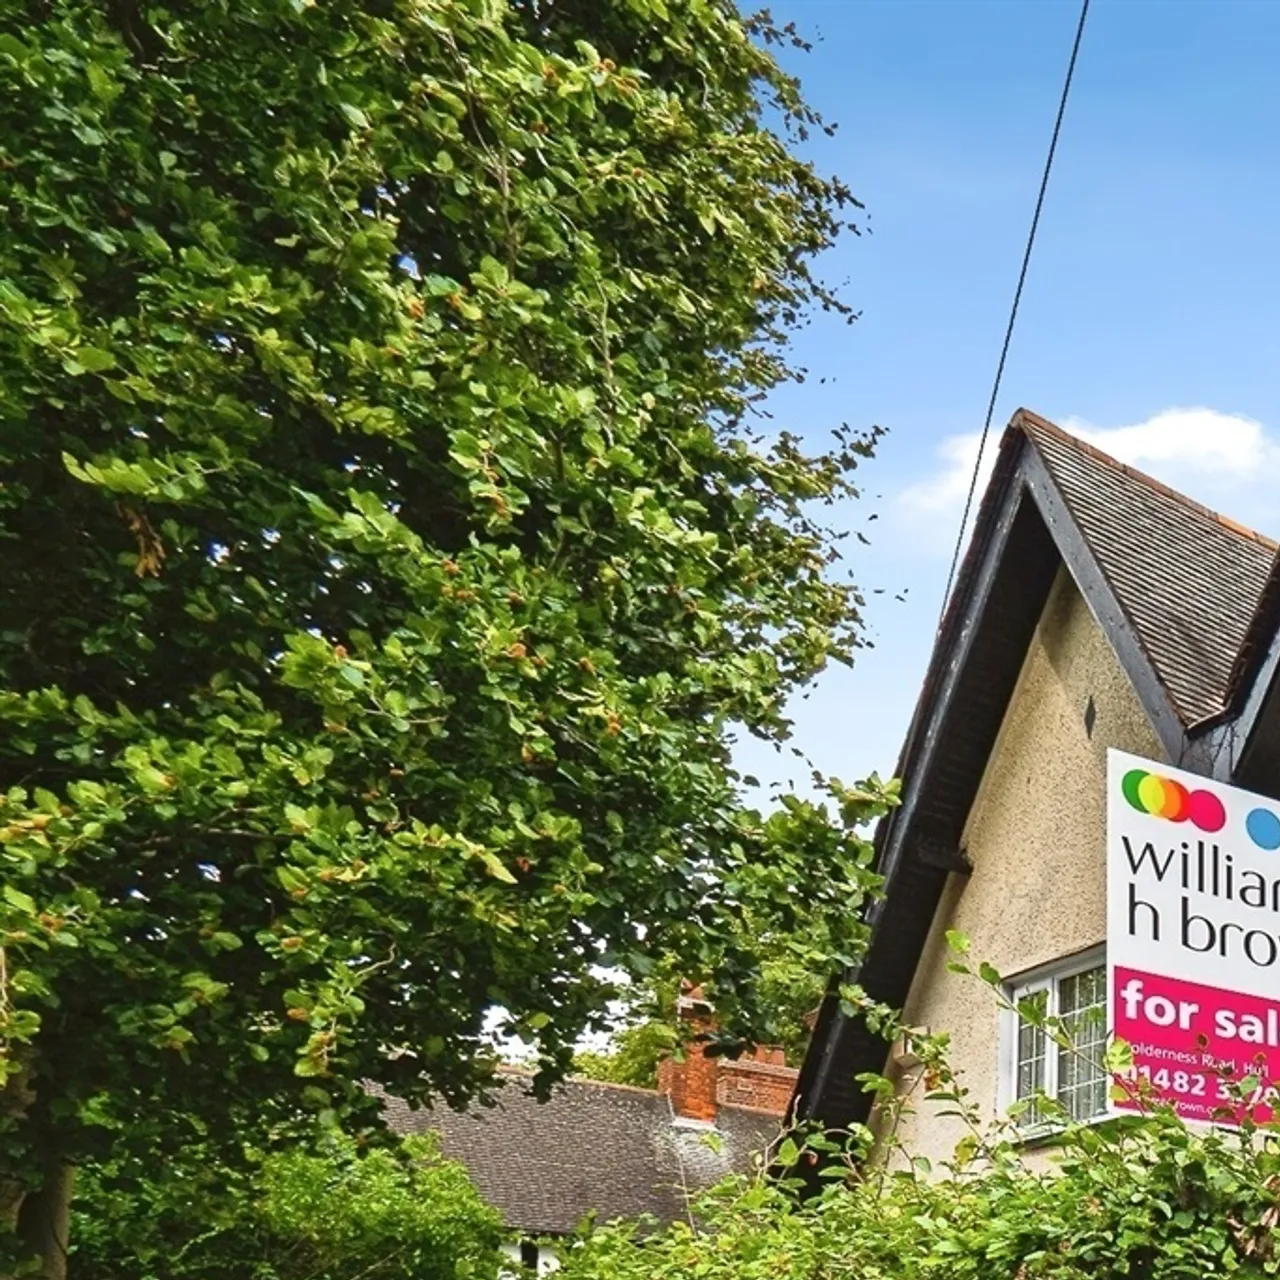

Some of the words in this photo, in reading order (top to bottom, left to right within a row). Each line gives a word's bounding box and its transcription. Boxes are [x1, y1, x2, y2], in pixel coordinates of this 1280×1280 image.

[1128, 882, 1160, 942] h
[1120, 979, 1200, 1030] for
[1128, 1041, 1197, 1065] olderness
